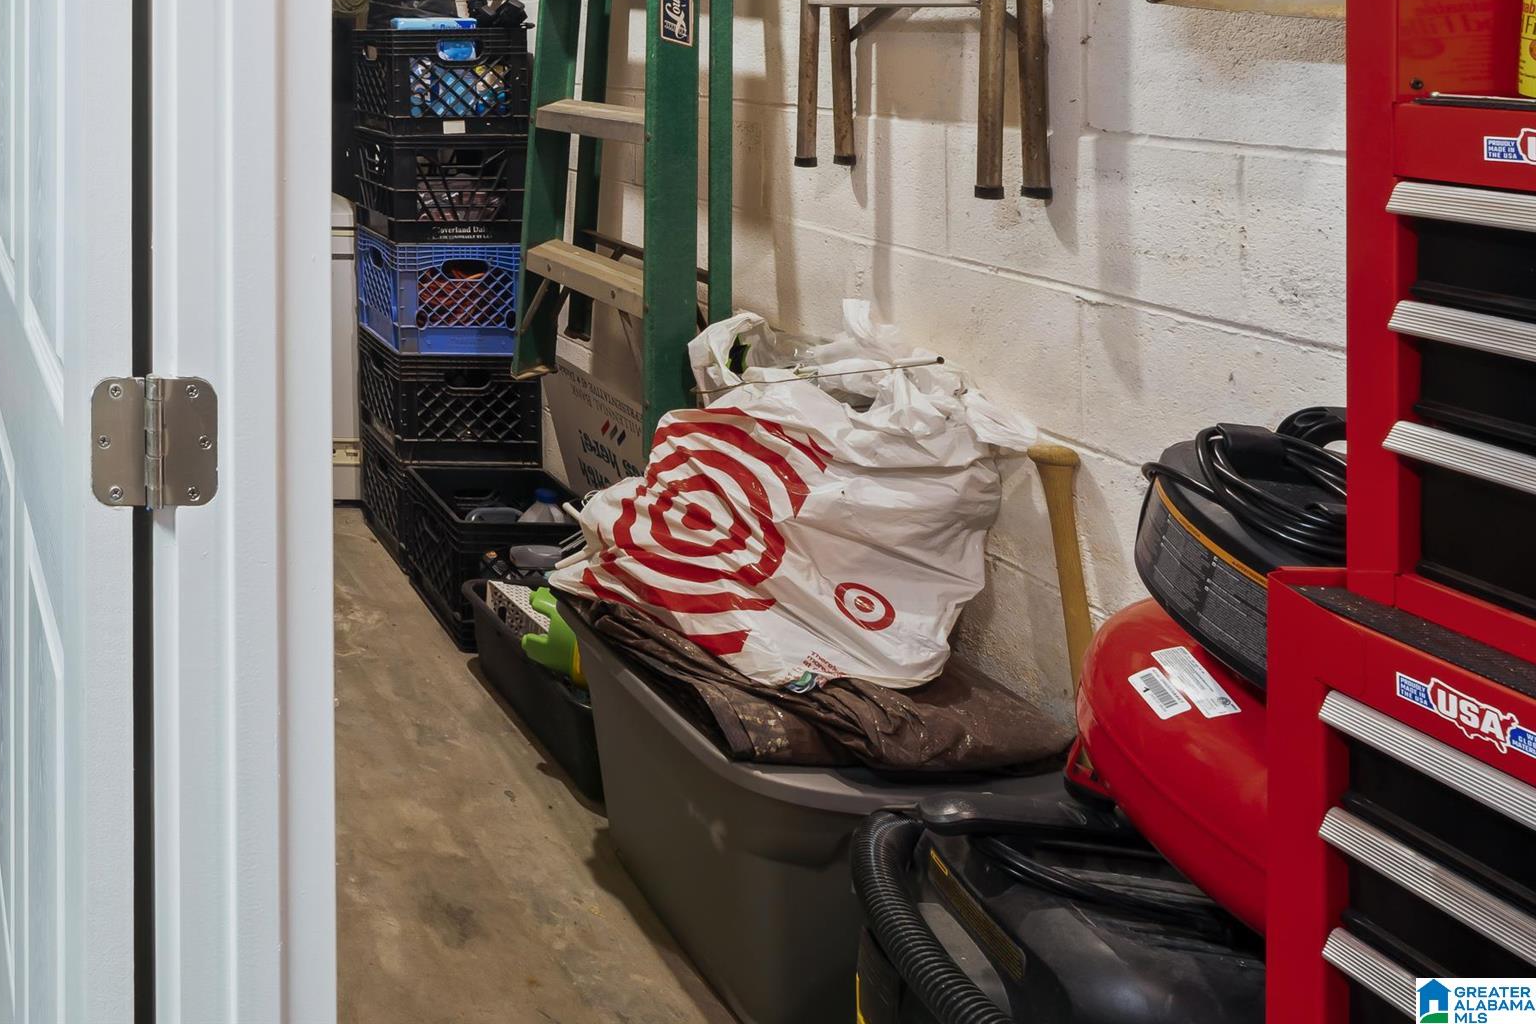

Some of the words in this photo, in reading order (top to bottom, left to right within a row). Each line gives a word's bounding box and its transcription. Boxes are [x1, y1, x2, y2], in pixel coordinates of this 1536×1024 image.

[1400, 677, 1426, 692] PROUDLY
[1400, 684, 1418, 696] MADE
[1400, 689, 1414, 701] THE
[1414, 695, 1428, 706] USA
[1437, 688, 1505, 742] USA
